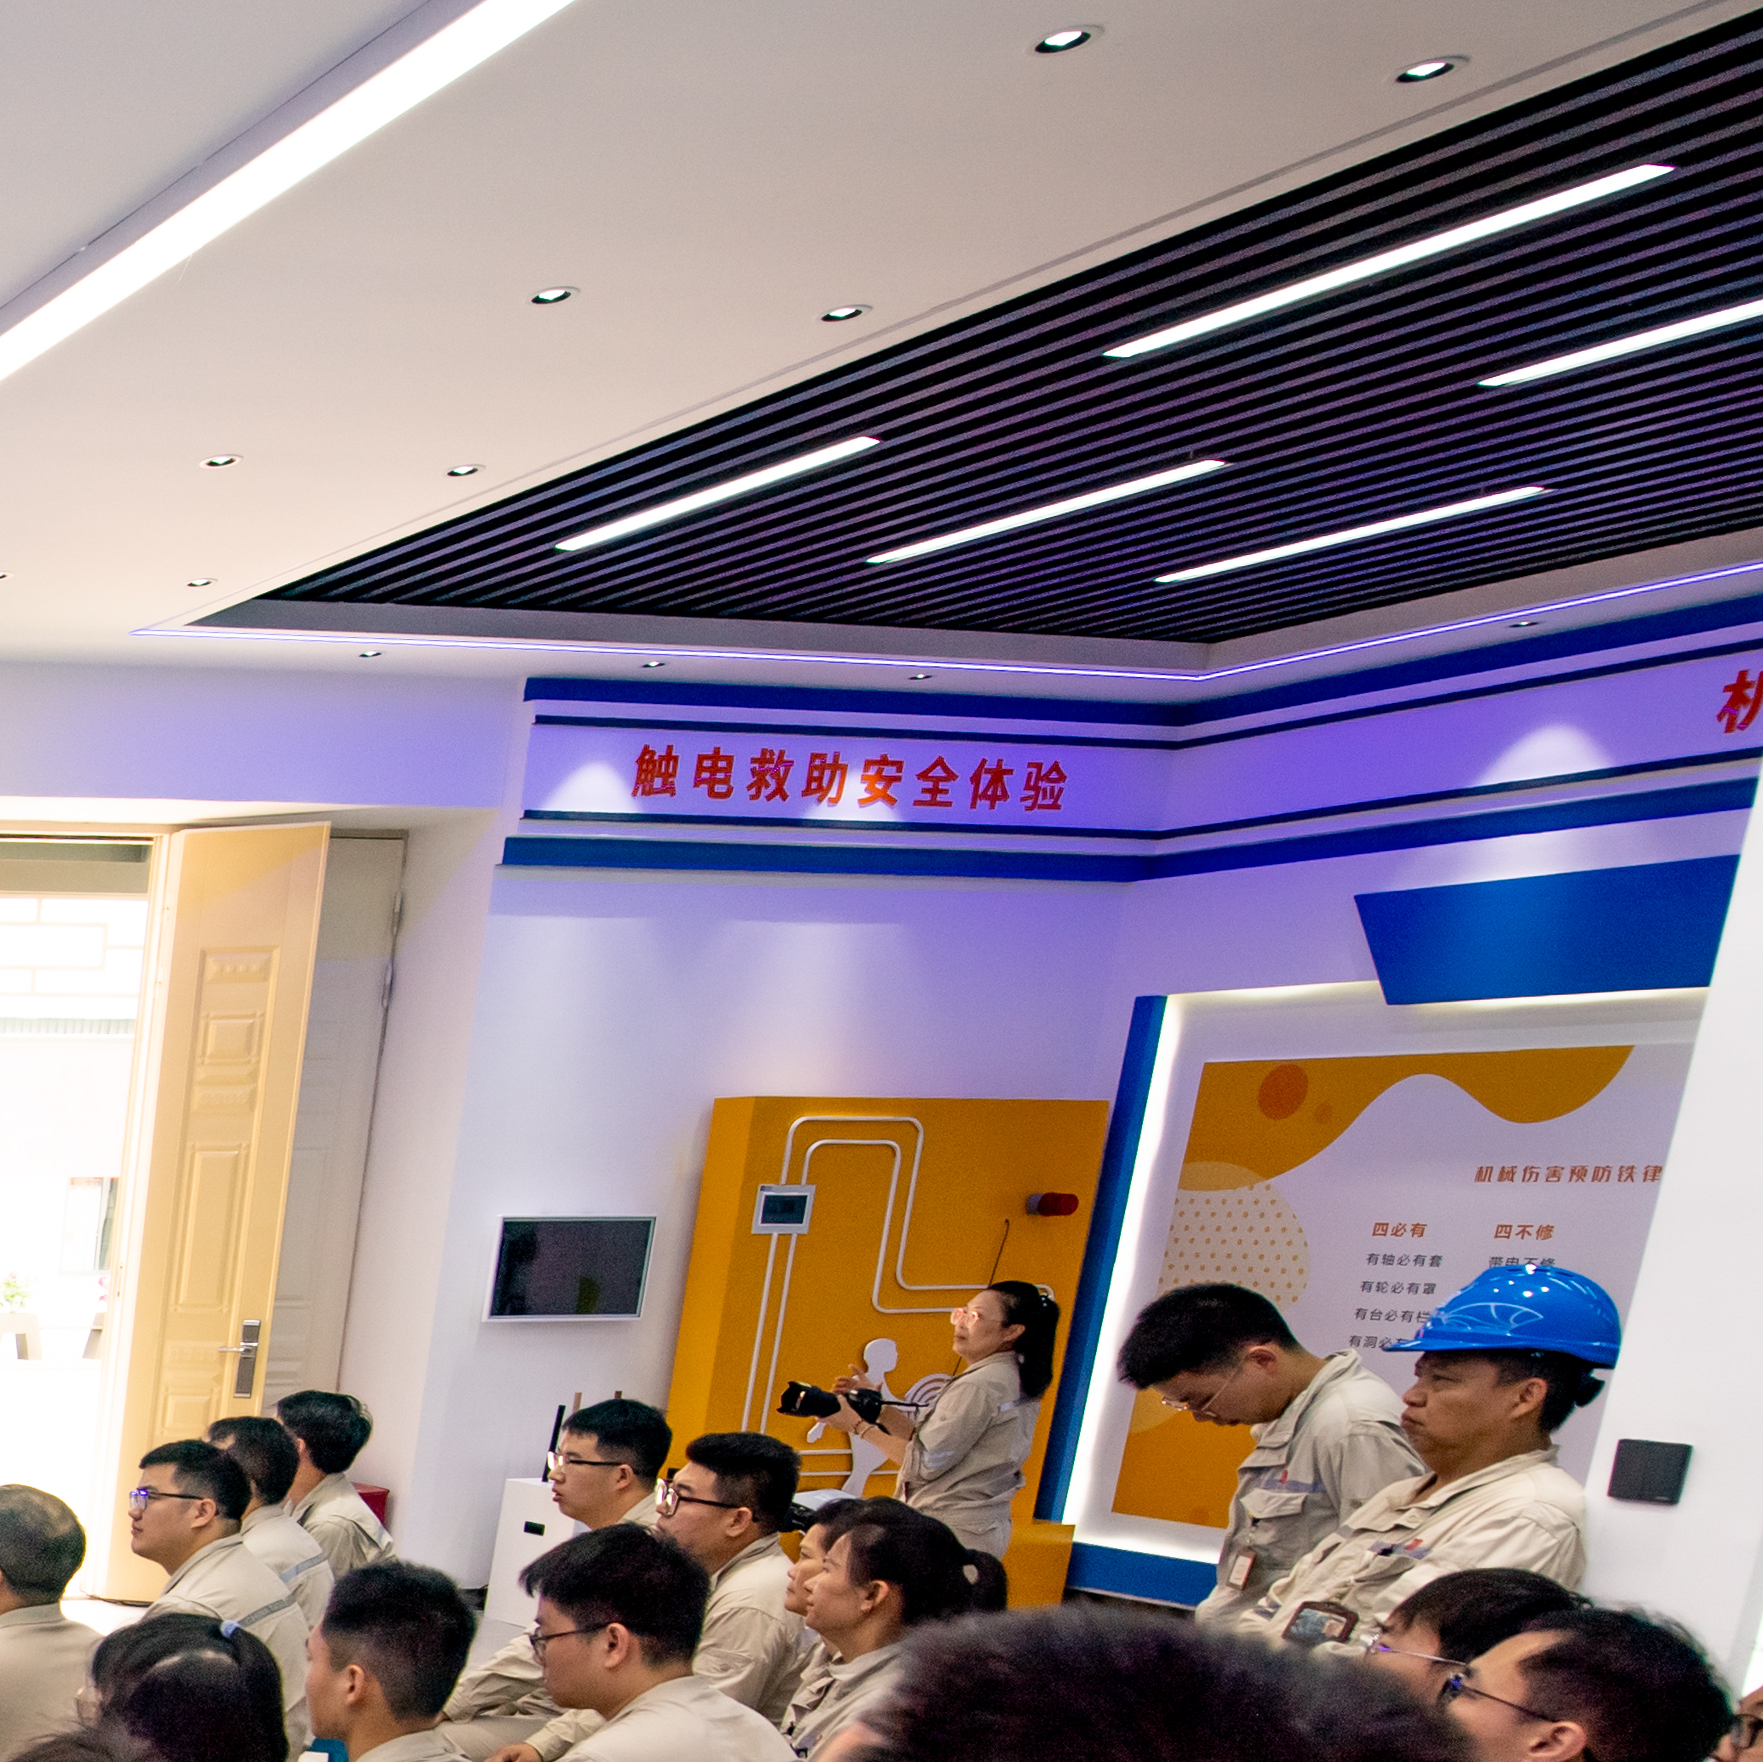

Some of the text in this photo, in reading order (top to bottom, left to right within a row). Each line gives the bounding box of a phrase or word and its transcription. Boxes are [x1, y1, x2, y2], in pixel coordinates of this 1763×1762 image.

[631, 743, 1068, 811] 触电救助安全体验
[1474, 1164, 1664, 1184] 机械伤害预防铁律
[1371, 1222, 1428, 1239] 四必有
[1494, 1223, 1555, 1241] 四不修
[1366, 1252, 1443, 1268] 有轴必有套
[1360, 1280, 1436, 1296] 有轮必有罩
